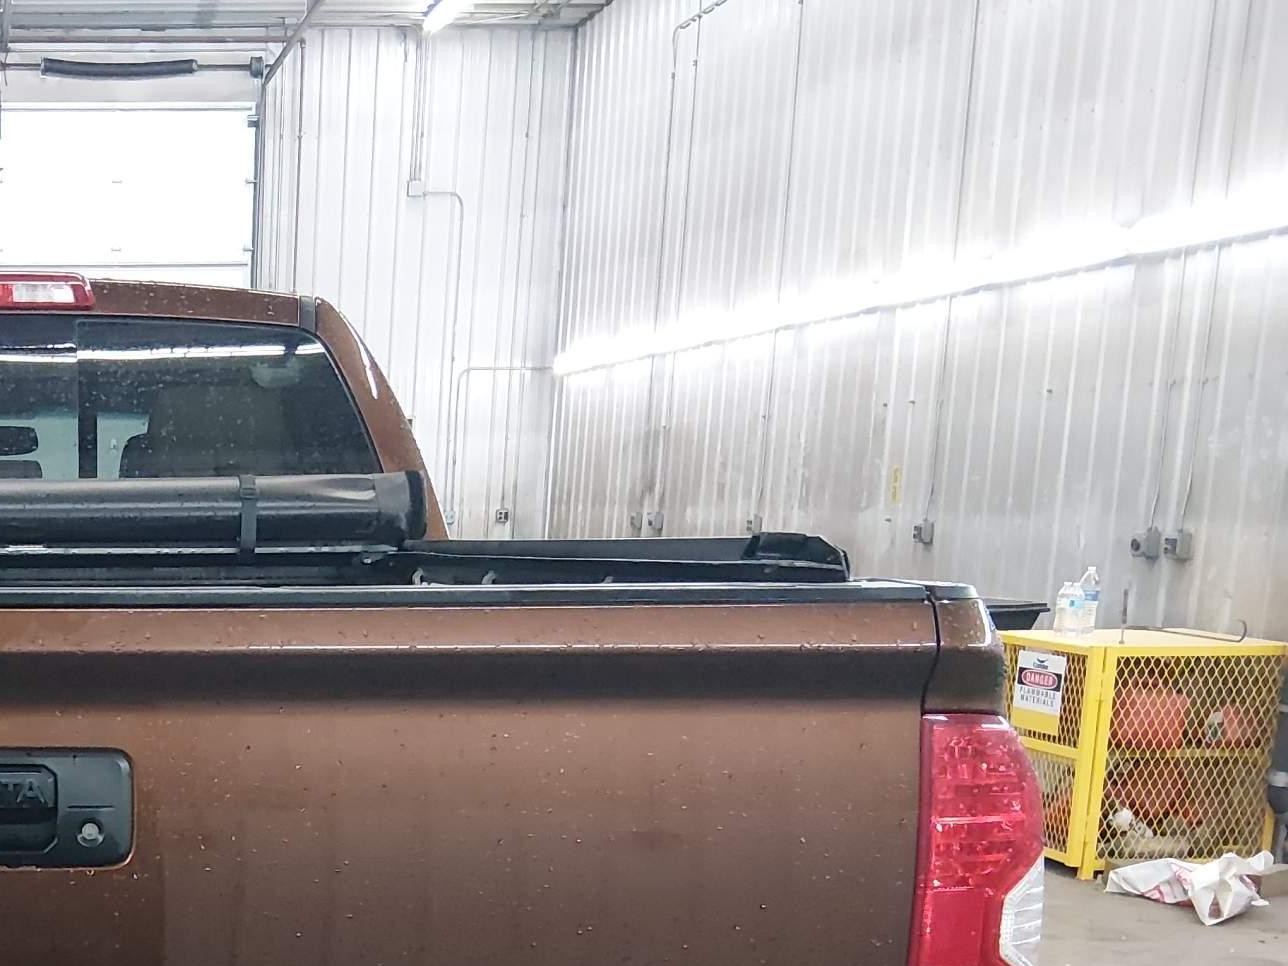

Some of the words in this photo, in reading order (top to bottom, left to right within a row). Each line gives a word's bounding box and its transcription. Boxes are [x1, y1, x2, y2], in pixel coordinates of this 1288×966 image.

[1025, 672, 1053, 686] DANGER
[1020, 686, 1056, 699] FLAMMABLE
[1020, 694, 1054, 707] MATERIALS
